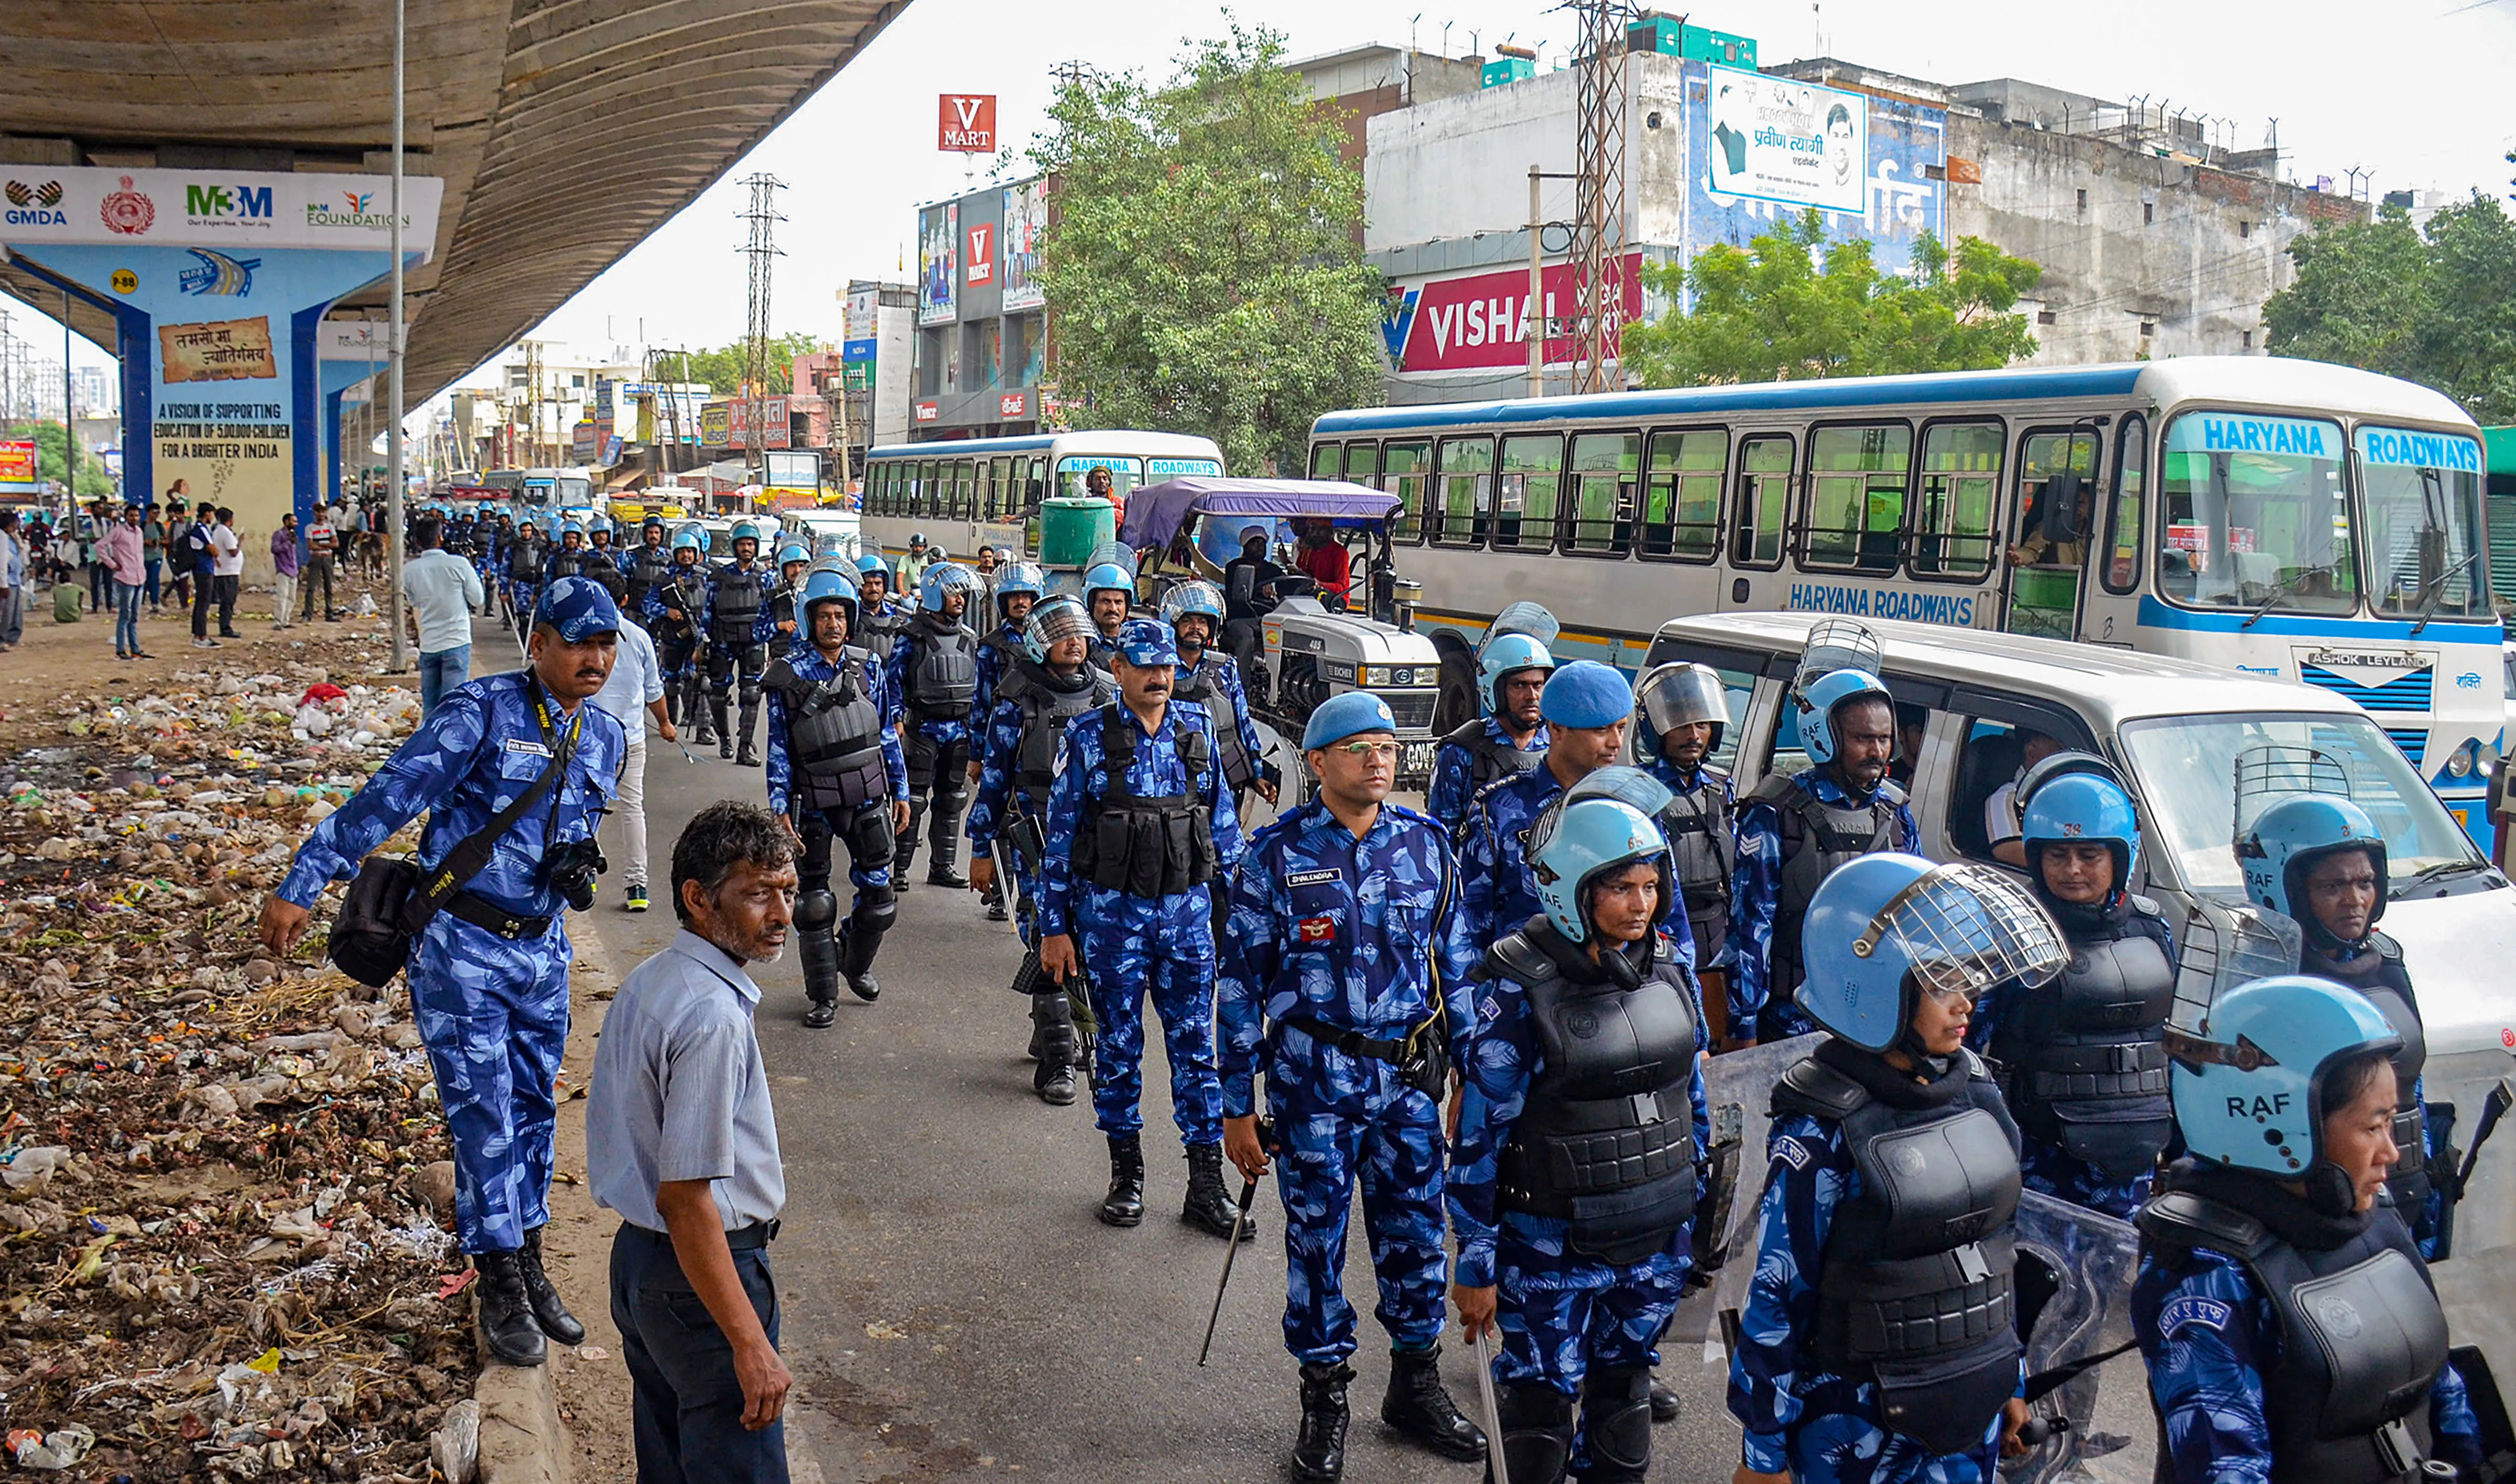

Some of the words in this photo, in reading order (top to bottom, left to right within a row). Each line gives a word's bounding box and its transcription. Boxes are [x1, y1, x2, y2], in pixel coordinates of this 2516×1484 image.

[952, 99, 983, 130] V
[945, 130, 990, 146] MART
[187, 185, 273, 217] M3M
[6, 210, 68, 225] GMDA
[972, 230, 987, 263] V
[1428, 292, 1555, 360] VISHAL
[215, 329, 231, 343] मा
[159, 403, 166, 418] A
[168, 403, 200, 419] VISION
[203, 403, 213, 418] OF
[215, 403, 281, 419] SUPPORTING
[154, 423, 202, 438] EDUCATION
[204, 423, 214, 438] OF
[162, 443, 179, 458] FOR
[182, 444, 189, 457] A
[192, 444, 240, 458] BRIGHTER
[244, 444, 279, 458] INDIA
[2204, 419, 2324, 455] HARYANA
[2367, 433, 2478, 471] ROADWAYS
[1071, 459, 1130, 472] HARYANA
[1153, 461, 1215, 475] ROADWAYS
[1790, 583, 1869, 613] HARYANA
[1874, 591, 1972, 626] ROADWAYS
[2312, 653, 2360, 665] ASHOK
[2367, 655, 2427, 668] LEYLAND
[1334, 665, 1352, 678] EICHER
[537, 703, 550, 728] Nikon
[1053, 705, 1087, 715] POLIC
[1802, 722, 1820, 738] RAF
[429, 870, 456, 898] Nikon
[2246, 870, 2273, 887] RAF
[1537, 887, 1559, 907] RAF
[2227, 1093, 2290, 1117] RAF
